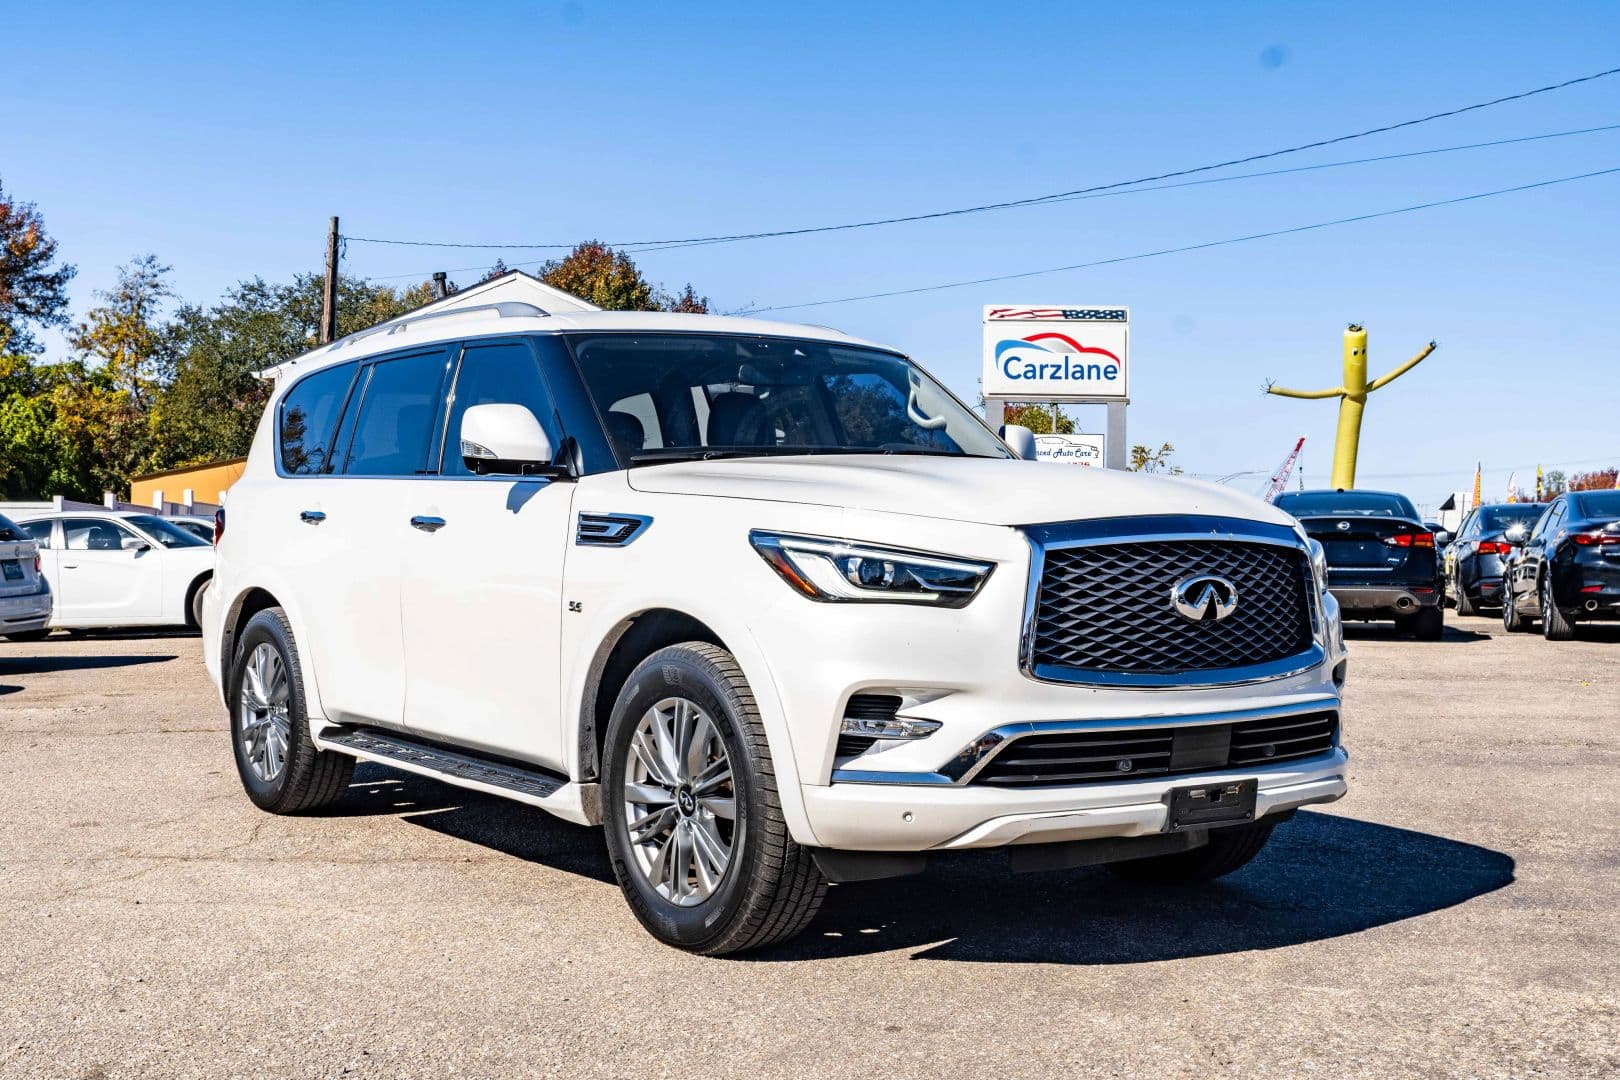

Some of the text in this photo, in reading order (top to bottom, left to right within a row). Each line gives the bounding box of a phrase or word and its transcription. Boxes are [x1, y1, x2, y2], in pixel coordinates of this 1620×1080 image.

[1003, 356, 1118, 380] Carzlane
[1052, 447, 1074, 459] Auto
[1074, 447, 1092, 458] Care
